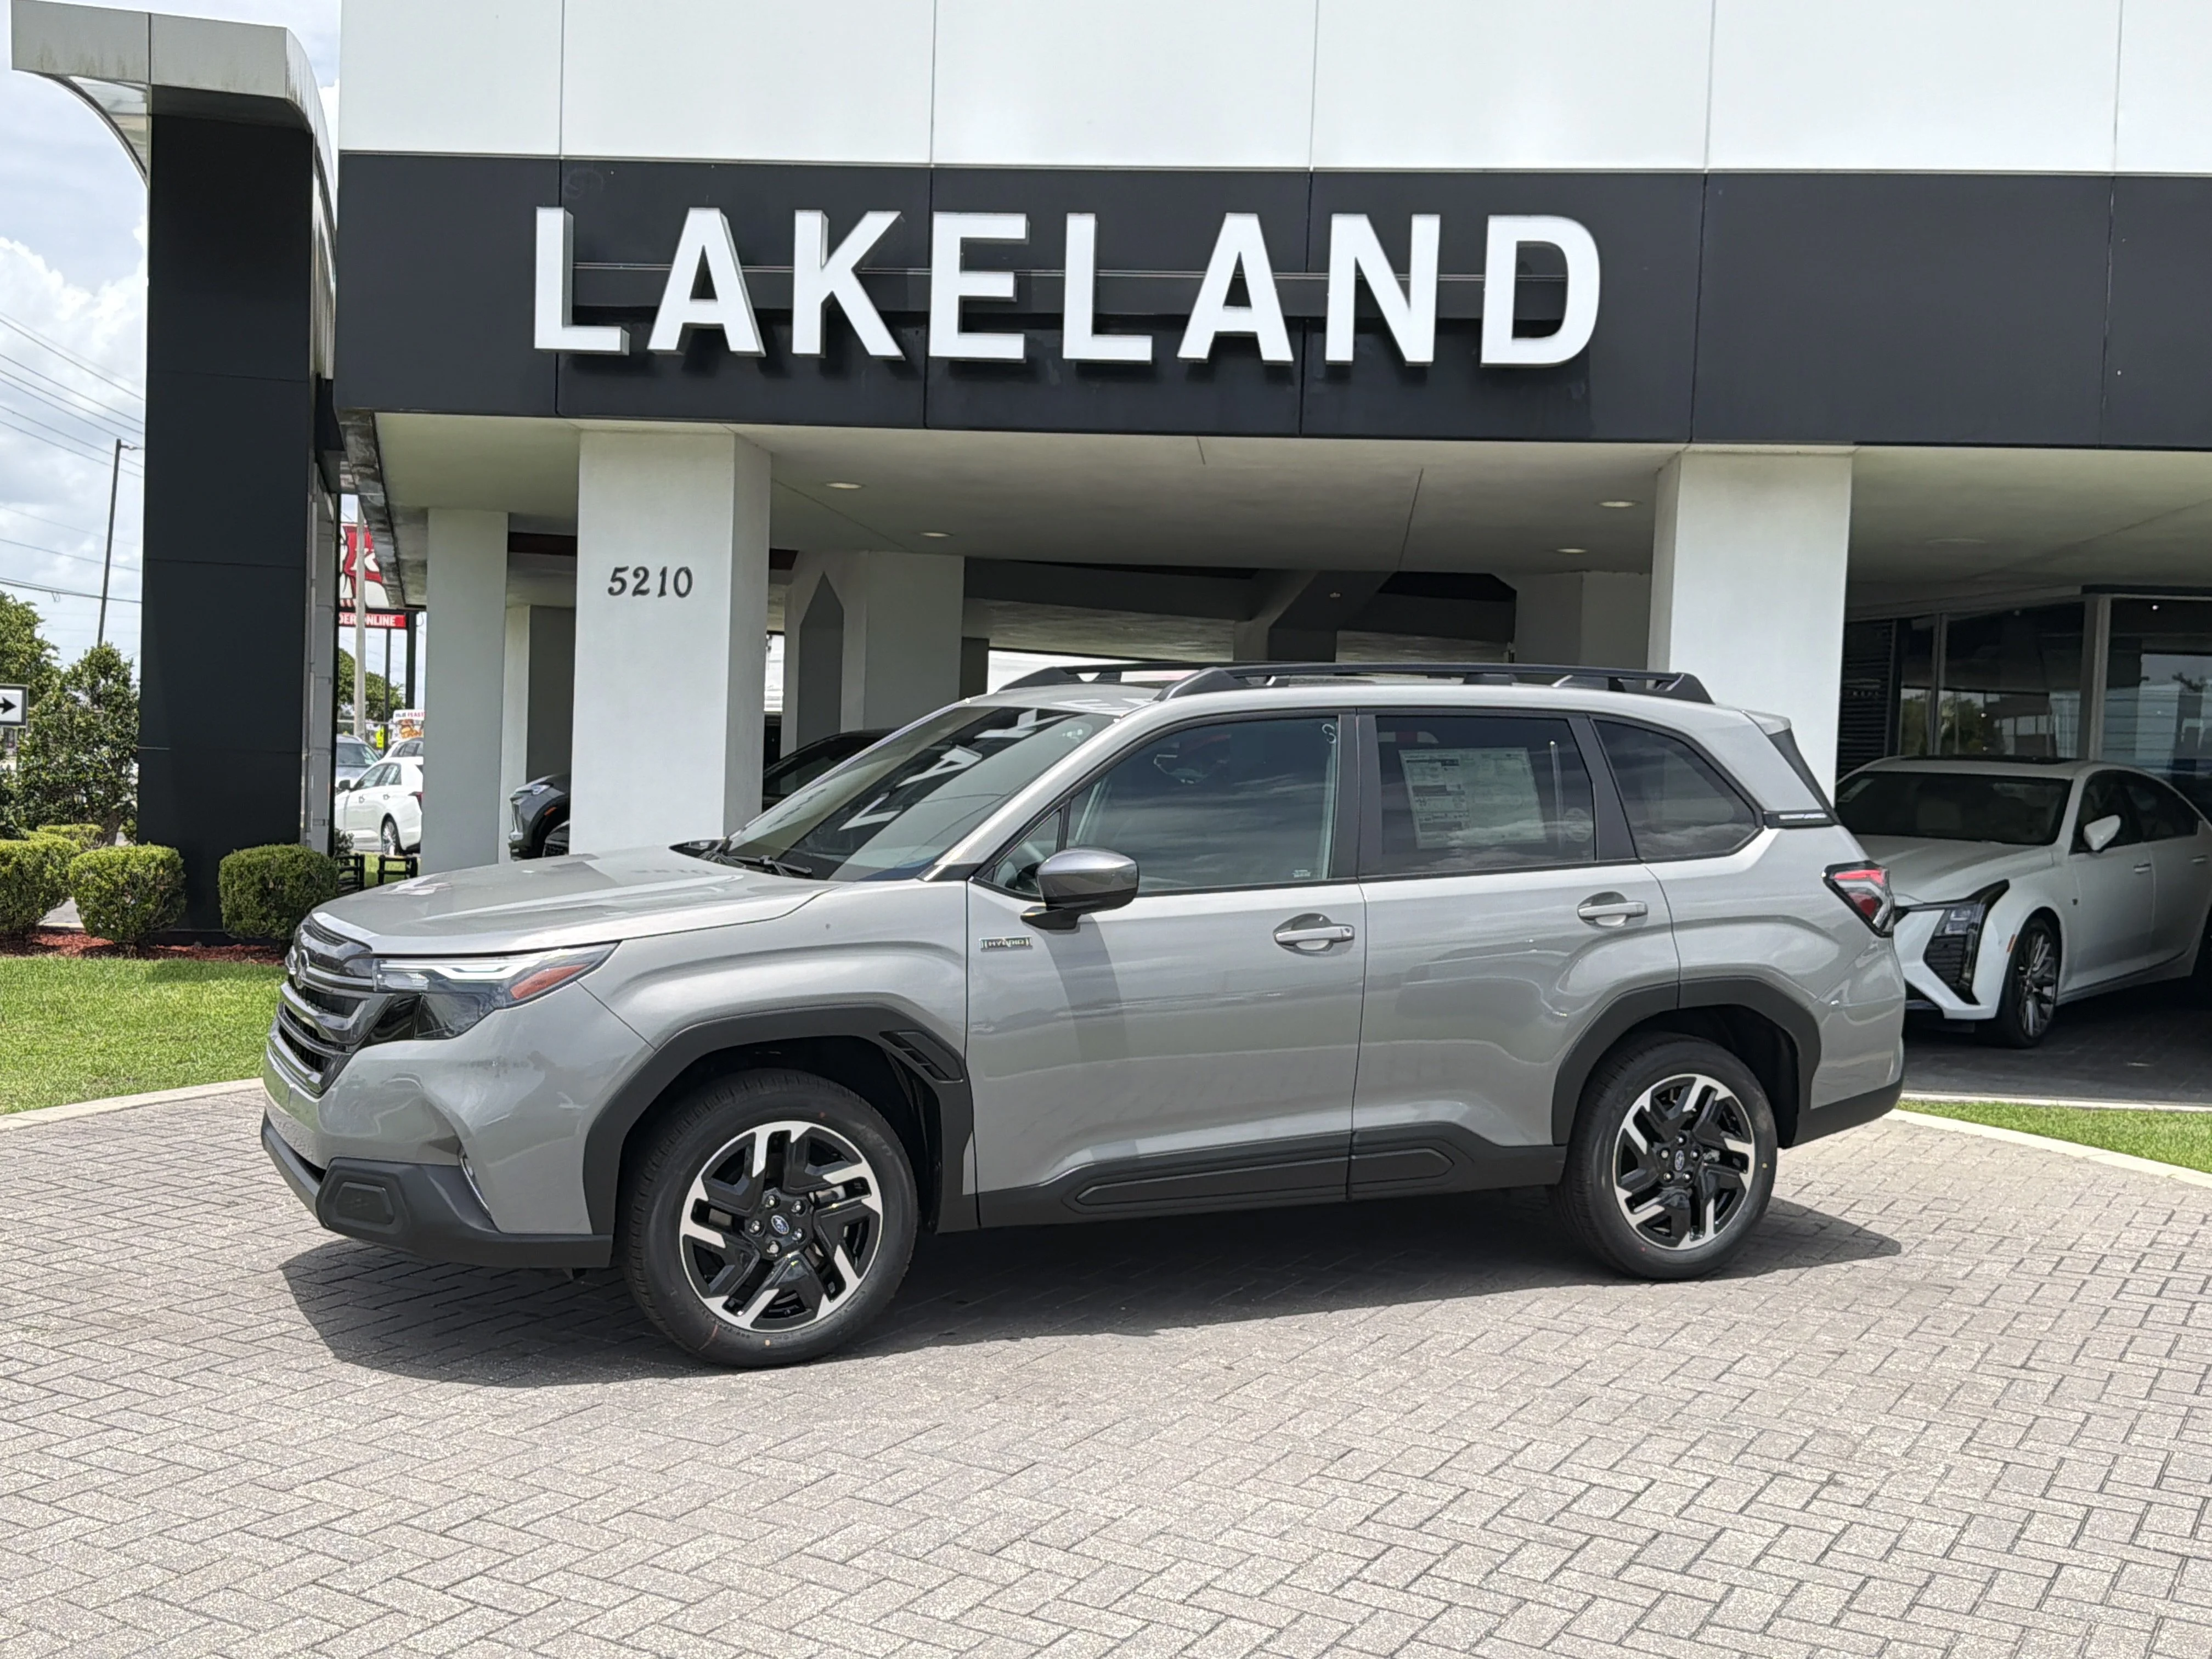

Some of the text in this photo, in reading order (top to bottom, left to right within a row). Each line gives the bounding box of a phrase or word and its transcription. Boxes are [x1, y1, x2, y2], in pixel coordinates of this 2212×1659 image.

[534, 206, 1601, 368] LAKELAND
[607, 566, 693, 599] 5210
[364, 614, 396, 627] NLINE
